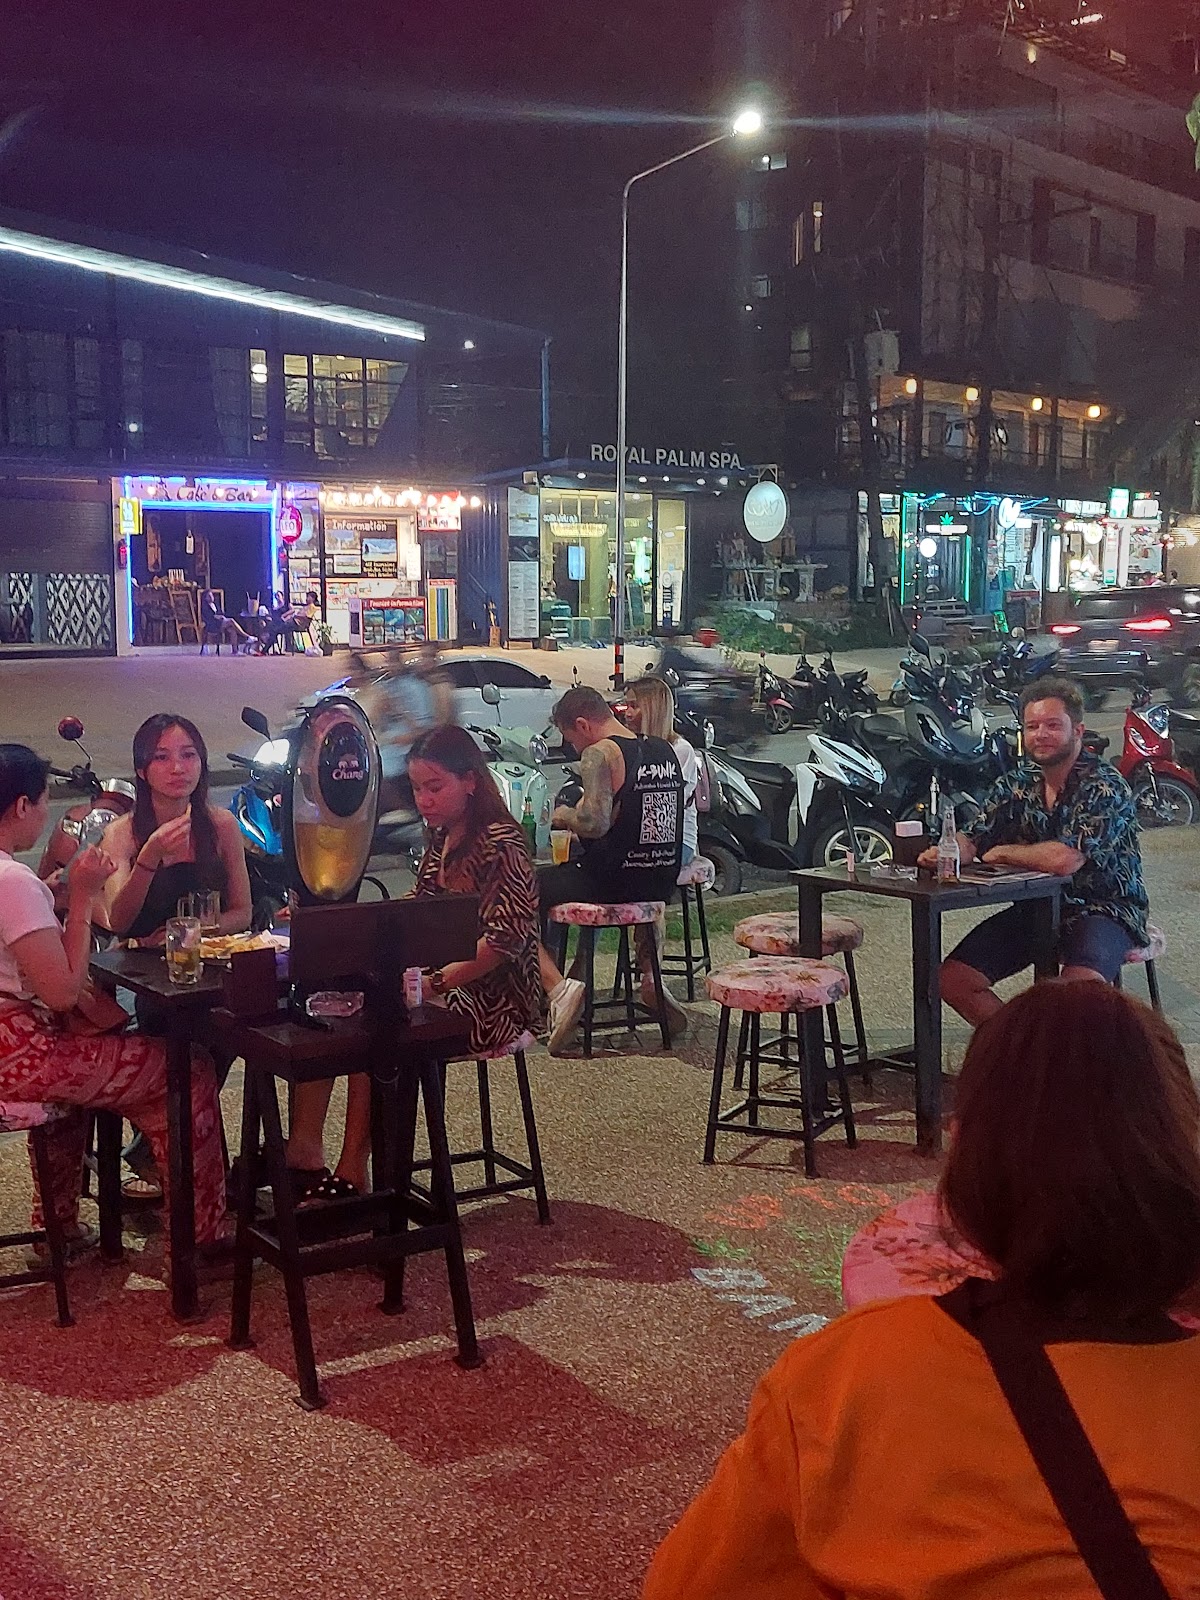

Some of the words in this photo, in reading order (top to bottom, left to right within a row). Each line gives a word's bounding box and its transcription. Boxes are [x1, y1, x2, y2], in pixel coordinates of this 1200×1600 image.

[591, 444, 651, 465] ROAL
[656, 448, 705, 468] PALM
[709, 451, 742, 470] SPA
[333, 519, 387, 532] Information
[332, 768, 364, 781] Chang
